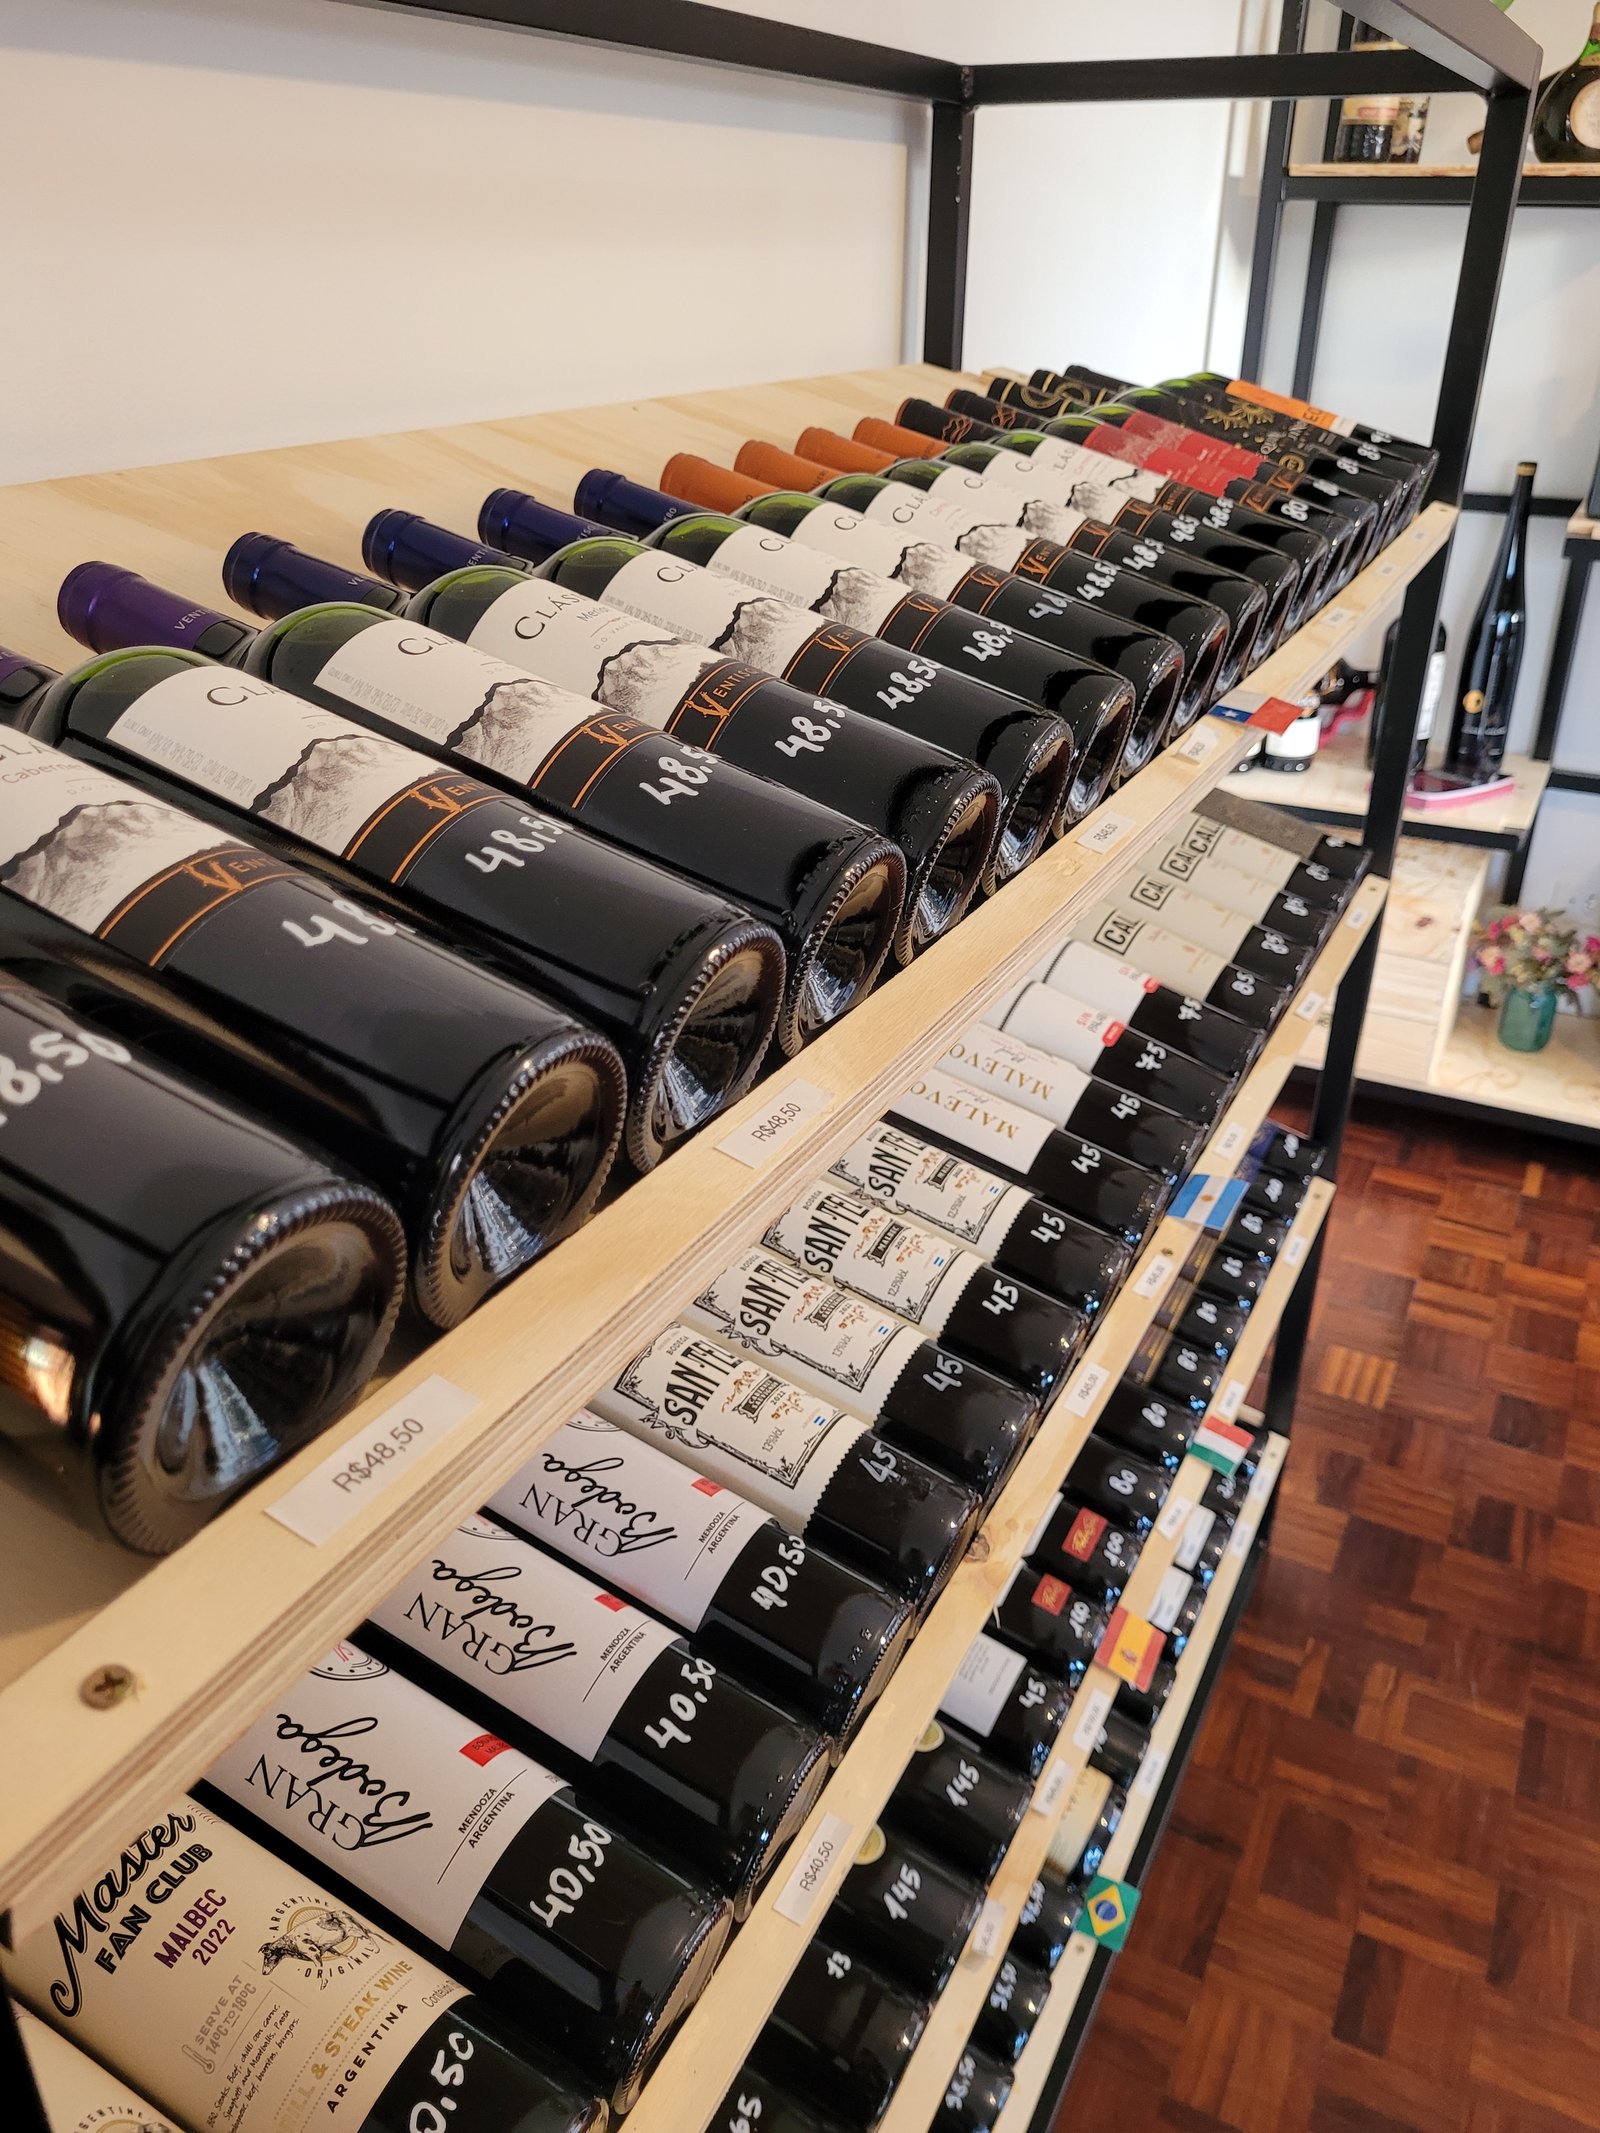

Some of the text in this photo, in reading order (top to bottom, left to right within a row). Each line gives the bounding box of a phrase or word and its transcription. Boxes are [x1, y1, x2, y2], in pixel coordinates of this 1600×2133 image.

[1281, 499, 1309, 521] 80
[0, 1032, 132, 1127] 8,50
[950, 1043, 1055, 1100] MALEVO
[751, 1103, 801, 1142] R$48,50
[910, 1081, 1020, 1139] MALEVO
[1110, 1093, 1141, 1119] 45
[1071, 1143, 1101, 1173] 45
[1030, 1212, 1066, 1243] 45
[981, 1279, 1019, 1315] 45
[922, 1353, 964, 1392] 45
[331, 1418, 424, 1494] R$48,50
[859, 1440, 900, 1484] 45
[519, 1482, 622, 1558] GRAN
[698, 1511, 726, 1544] MENDOZA
[708, 1514, 741, 1555] ARGENTINA
[403, 1592, 517, 1676] GRAN
[600, 1627, 631, 1662] MENDOZA
[609, 1631, 647, 1673] ARGENTINA
[644, 1657, 717, 1749] 40,50
[1018, 1677, 1047, 1708] 45
[244, 1753, 364, 1851] GRAN
[945, 1759, 980, 1807] 145
[458, 1787, 498, 1835] MENDOZA
[467, 1791, 516, 1849] ARGENTINA
[529, 1821, 613, 1928] 40,50
[799, 1840, 834, 1892] R$40,50
[883, 1862, 921, 1920] 145
[50, 1812, 196, 2018] Master
[94, 1843, 213, 1975] FAN CLUB
[154, 1888, 227, 1969] MALBEC
[192, 1918, 236, 1967] 2022
[303, 1946, 375, 1979] ORIGINAL
[195, 1974, 244, 2046] SERVE AT
[273, 2008, 291, 2031] Pasta
[310, 1959, 413, 2081] & STEAK WINE
[326, 2002, 409, 2114] ARGENTINA
